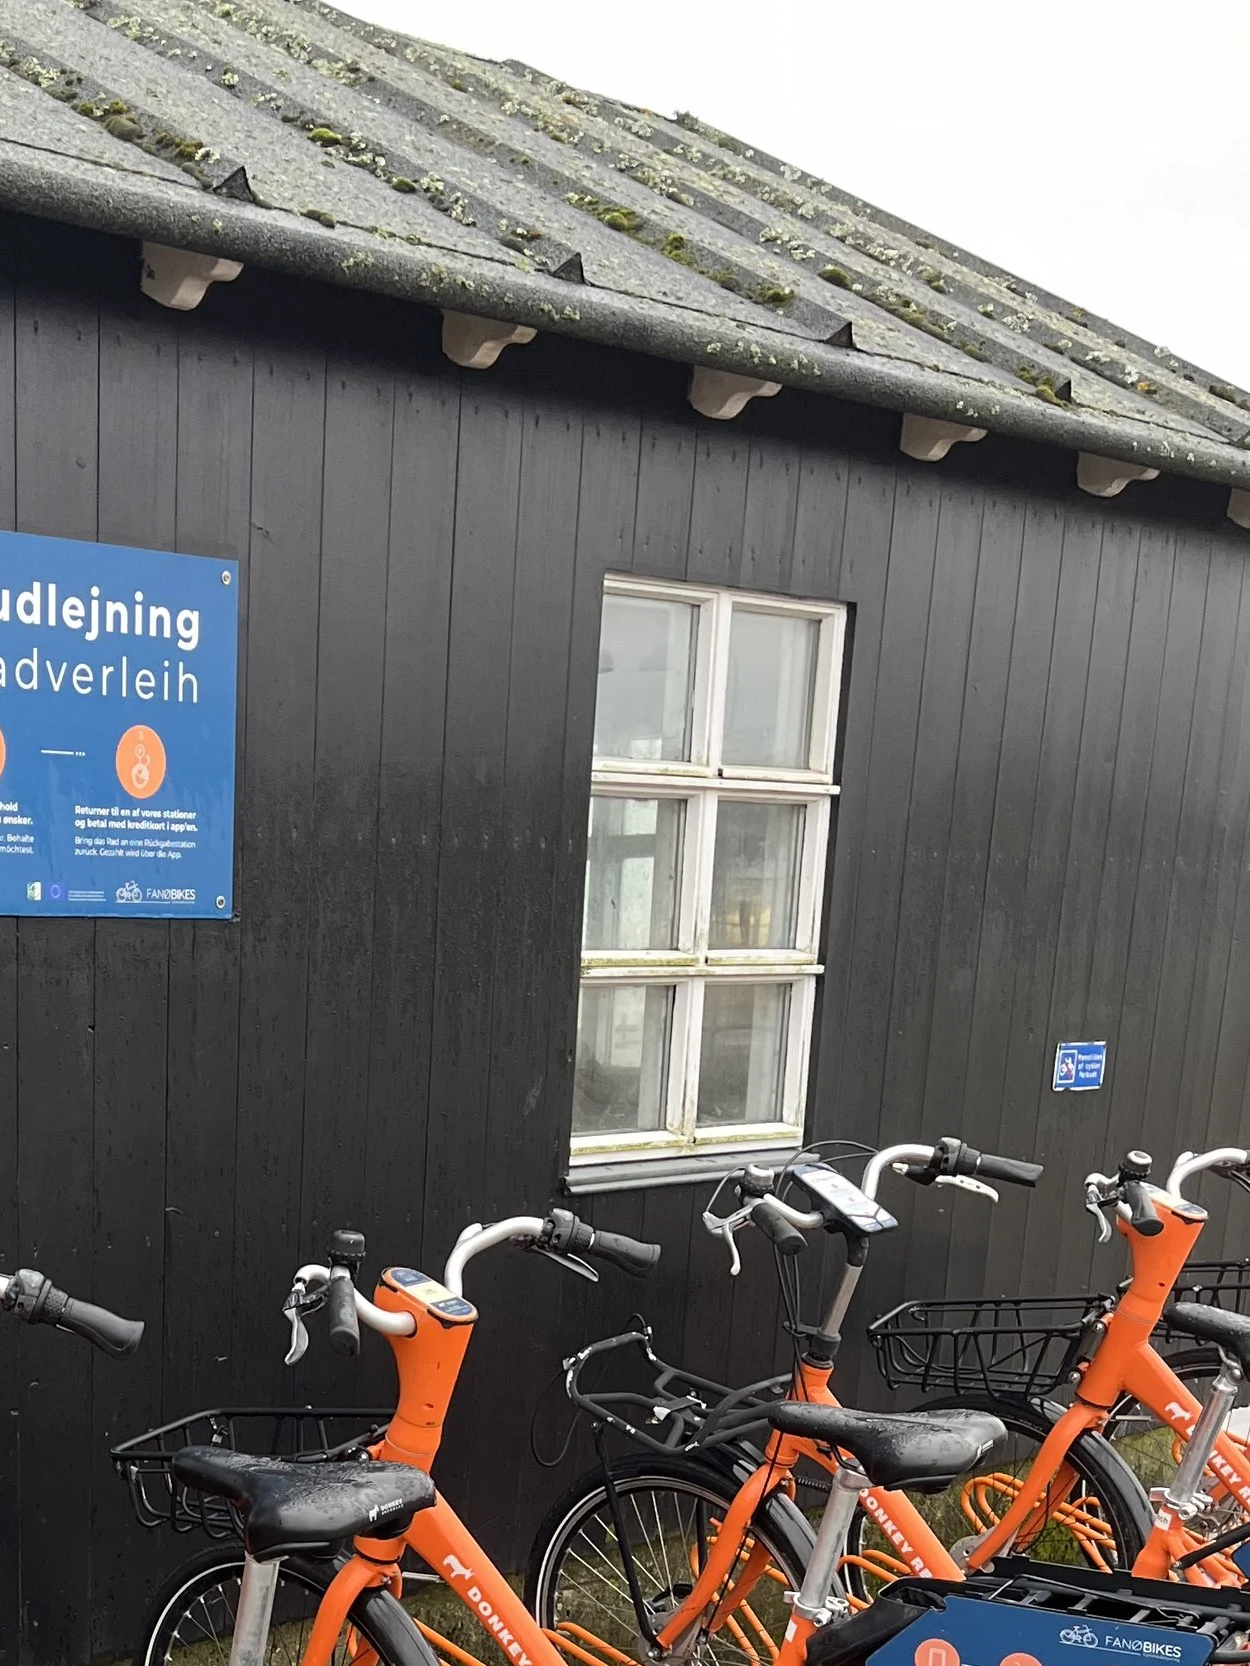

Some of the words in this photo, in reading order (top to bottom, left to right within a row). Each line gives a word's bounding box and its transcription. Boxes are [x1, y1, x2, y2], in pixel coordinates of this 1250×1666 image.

[74, 805, 110, 816] Returner
[111, 806, 119, 816] til
[120, 809, 131, 817] en
[132, 807, 140, 817] af
[141, 810, 162, 818] vores
[162, 809, 197, 820] stationer
[3, 815, 34, 825] ønsker.
[146, 888, 196, 900] FANØBIKES
[1105, 1635, 1182, 1658] FANØBIKES
